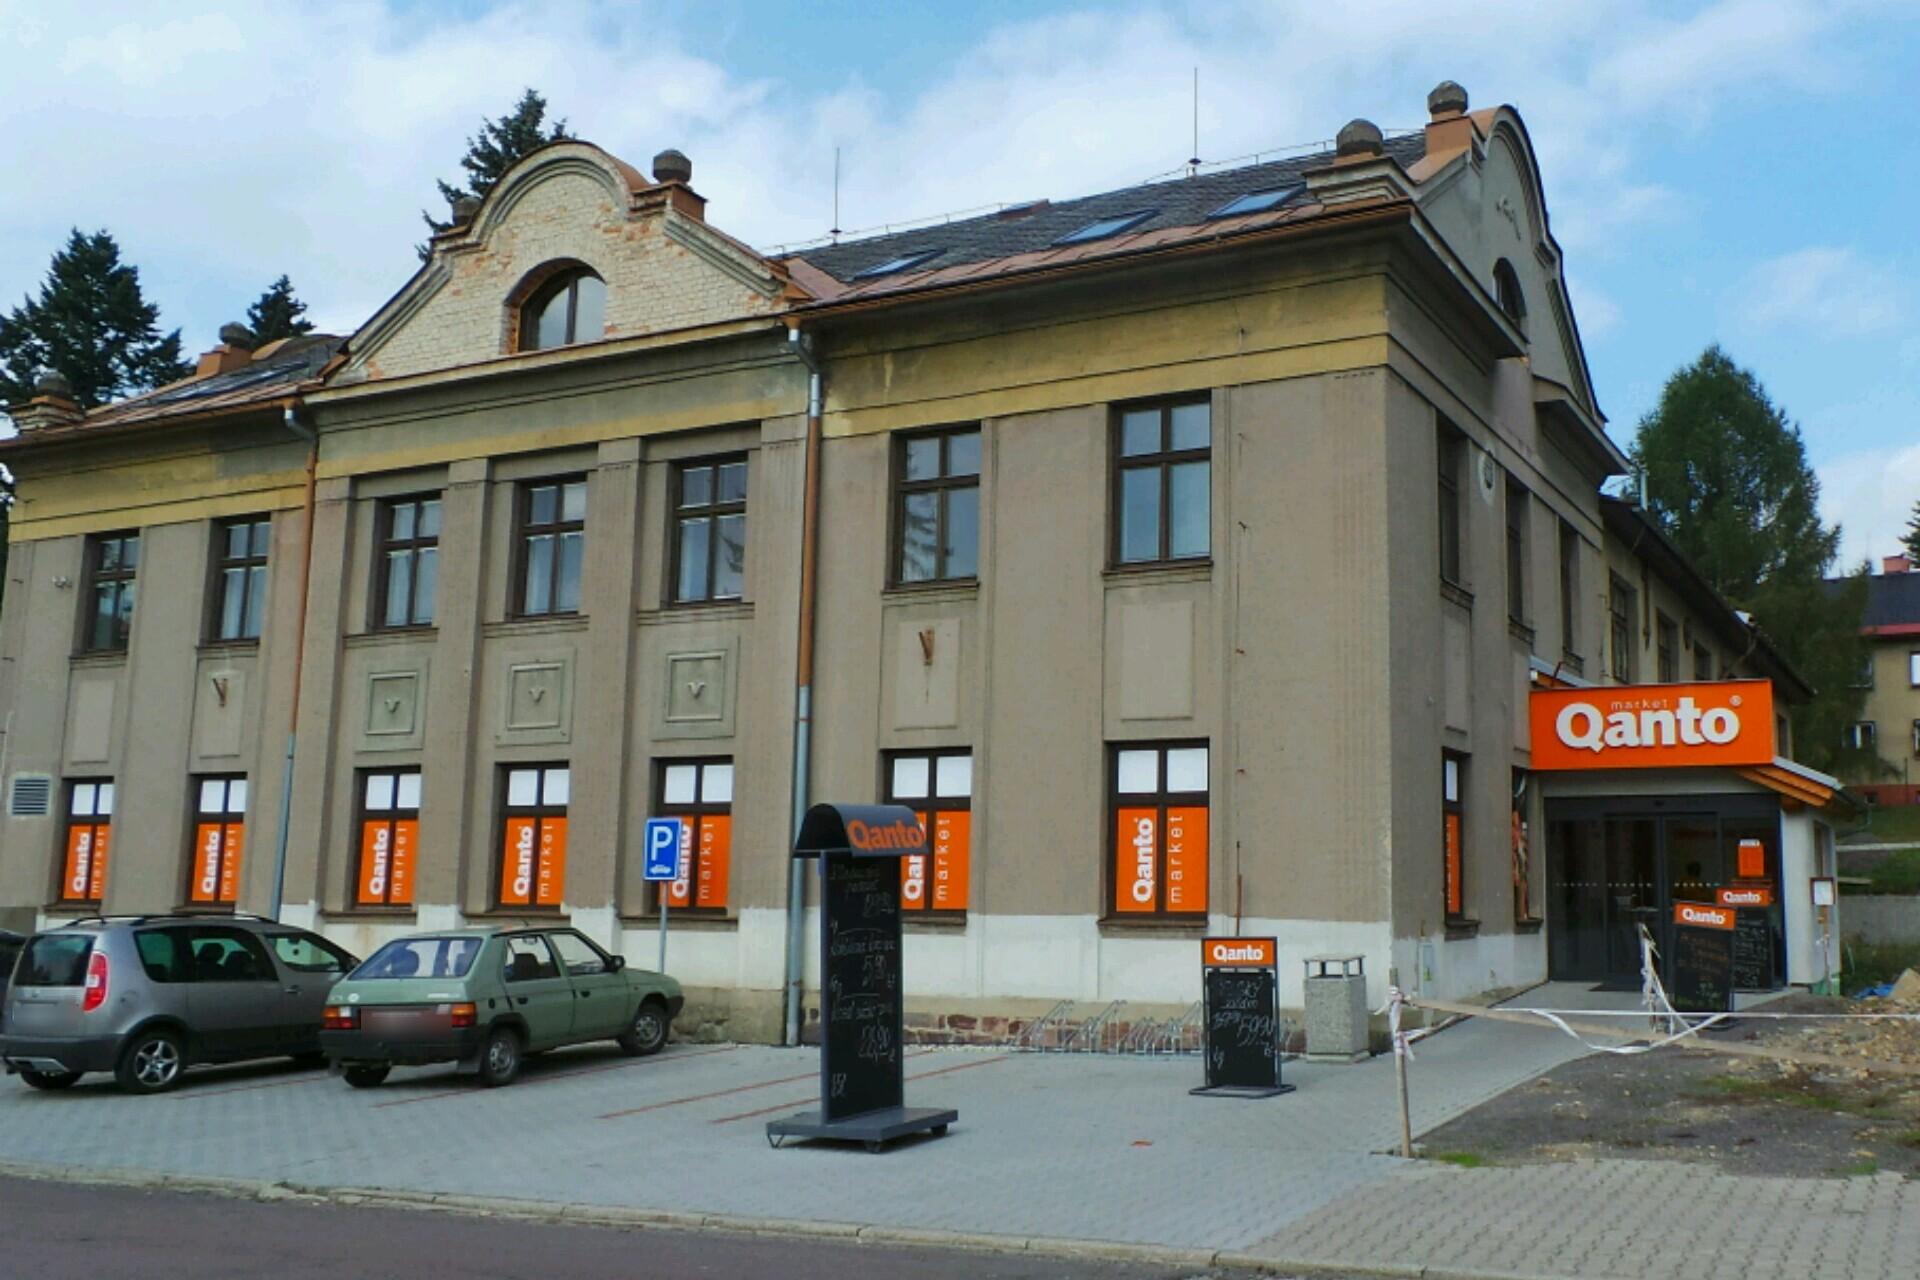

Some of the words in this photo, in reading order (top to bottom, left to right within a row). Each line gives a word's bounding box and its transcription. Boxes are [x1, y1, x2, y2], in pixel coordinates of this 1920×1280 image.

[1611, 699, 1668, 712] market
[72, 832, 91, 893] Qanto
[201, 831, 220, 894] Qanto
[369, 828, 389, 895] Qanto
[393, 828, 407, 896] market
[513, 826, 534, 897] Qanto
[540, 825, 553, 897] market
[651, 826, 673, 861] P
[700, 824, 714, 899] market
[847, 819, 926, 852] Qanto
[937, 819, 950, 901] market
[1132, 817, 1155, 903] Qanto
[1168, 816, 1183, 904] market
[1682, 908, 1725, 925] Qanto
[1723, 891, 1760, 903] Qanto
[1213, 944, 1264, 961] Qanto
